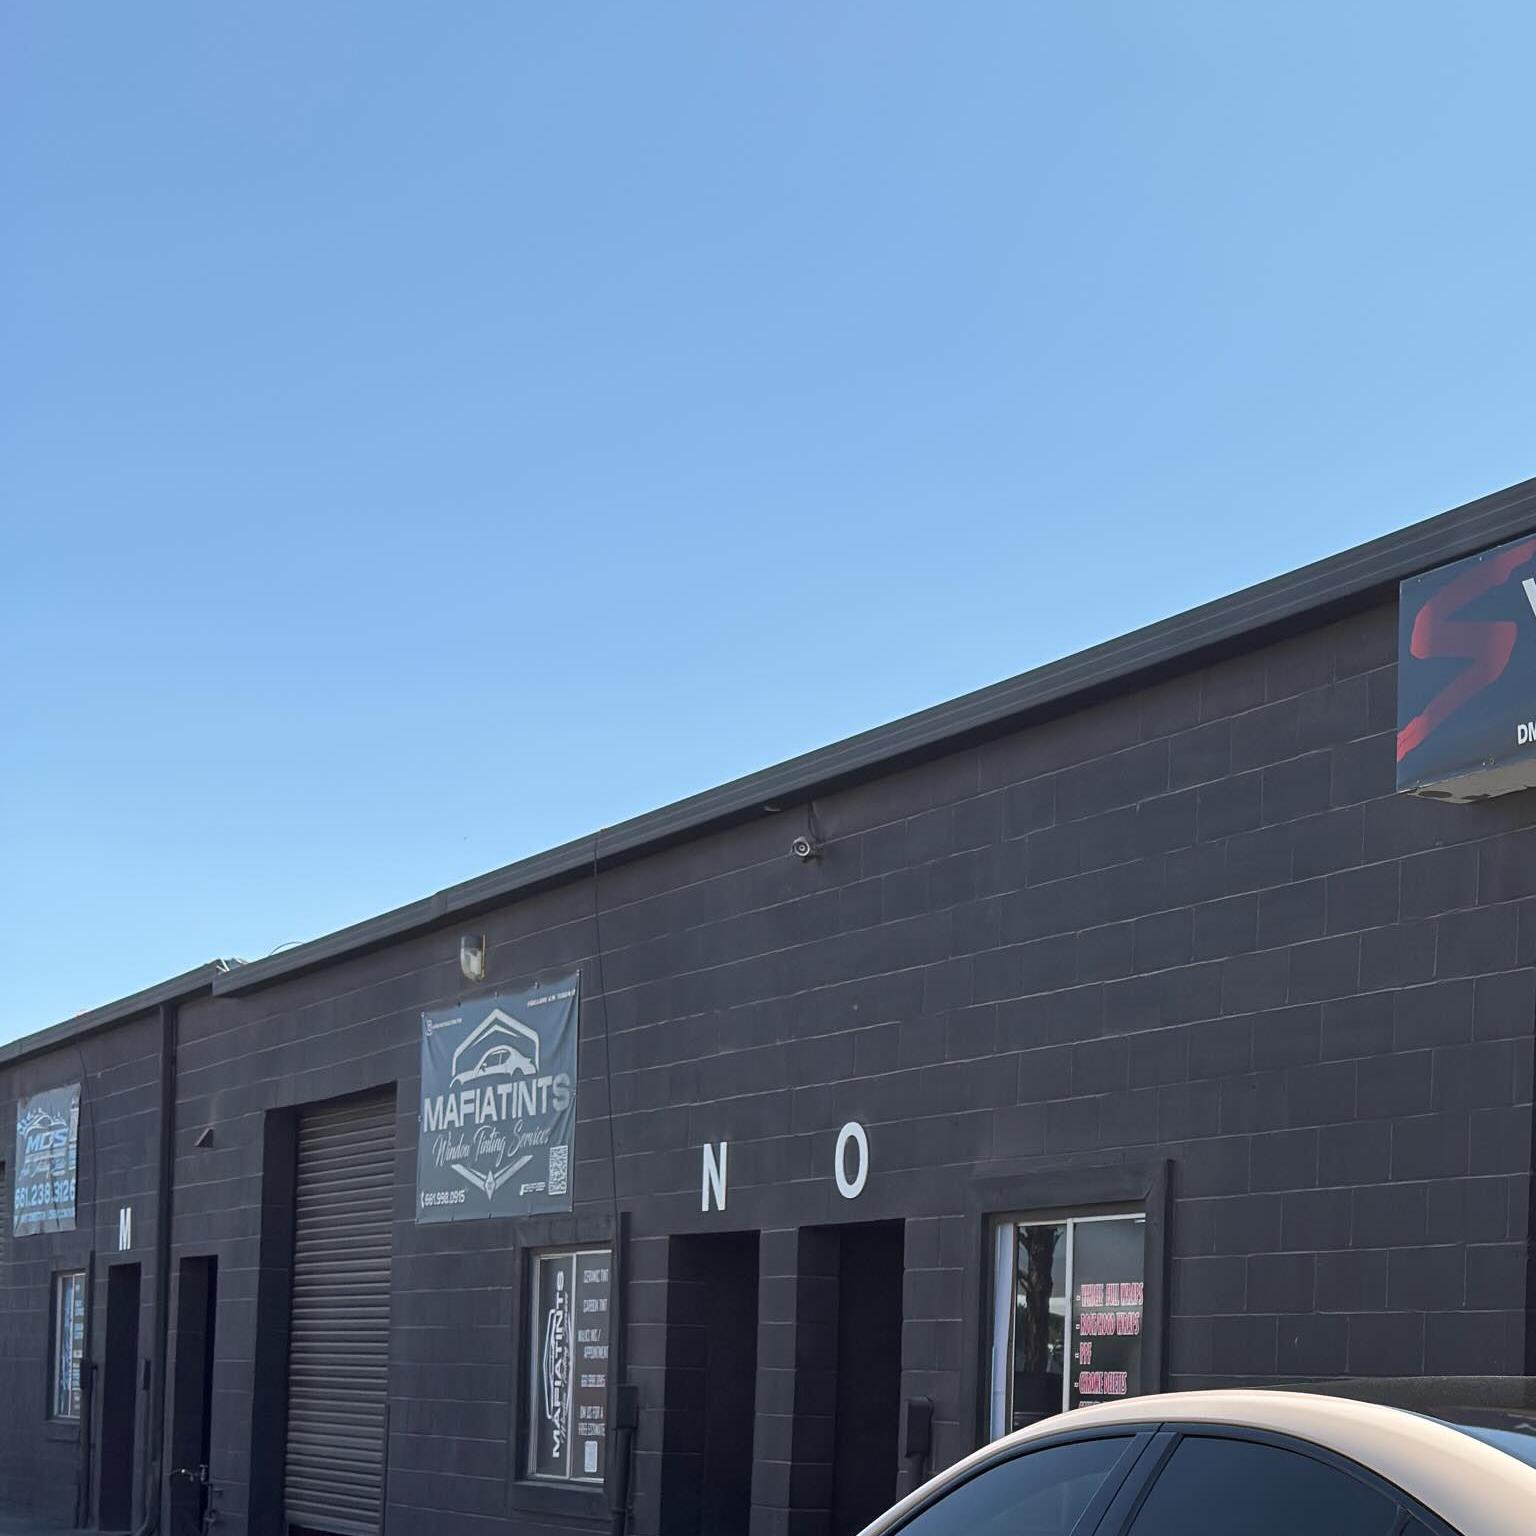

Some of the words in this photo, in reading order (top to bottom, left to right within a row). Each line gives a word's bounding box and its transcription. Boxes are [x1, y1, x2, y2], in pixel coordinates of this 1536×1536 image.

[423, 1073, 571, 1133] MAFIATINTS
[473, 1125, 506, 1167] Tinting
[702, 1141, 728, 1212] N
[834, 1121, 869, 1199] O
[119, 1207, 132, 1251] M
[552, 1270, 565, 1458] MAFIATINTS
